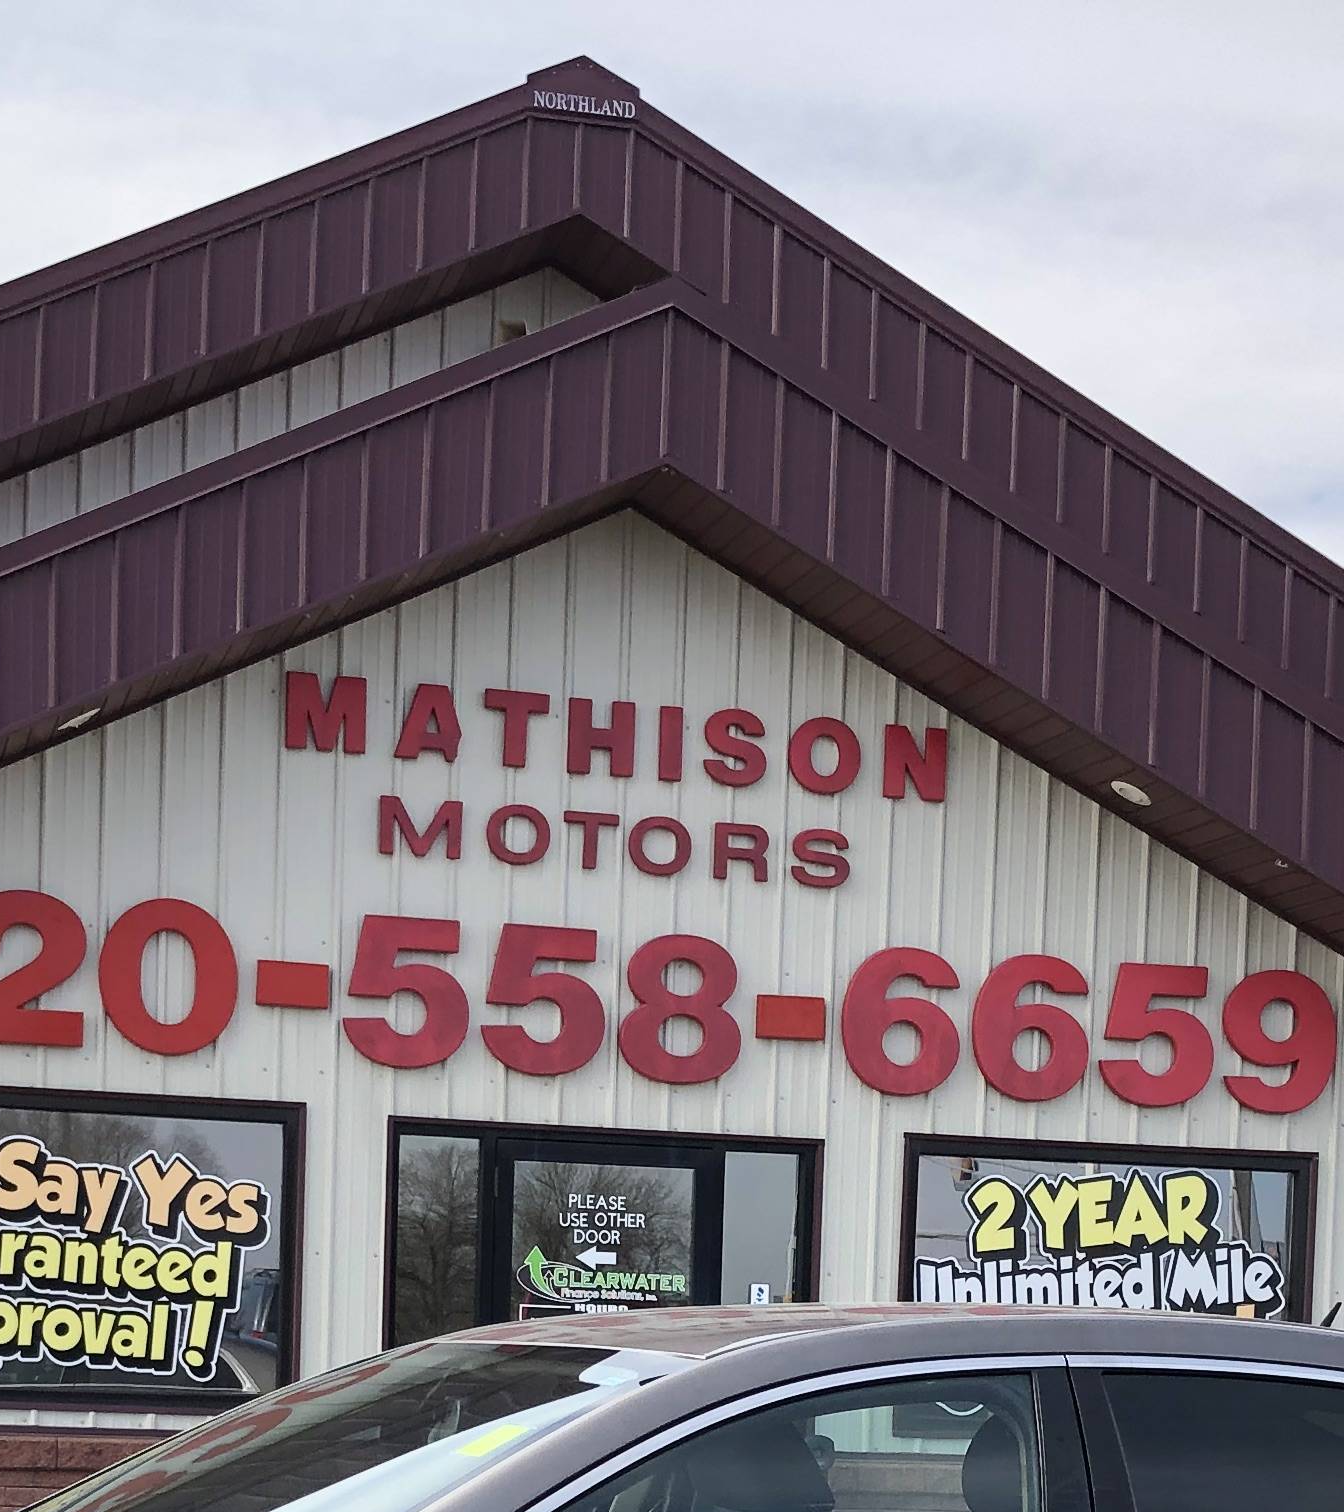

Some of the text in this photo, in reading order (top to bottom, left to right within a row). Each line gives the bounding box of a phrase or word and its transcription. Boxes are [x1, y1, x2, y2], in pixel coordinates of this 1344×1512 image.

[533, 90, 636, 119] NORTHLAND
[285, 670, 947, 802] MATHISON
[377, 795, 850, 888] MOTORS
[131, 1153, 261, 1236] Yes
[568, 1193, 627, 1211] PLEASE
[967, 1172, 1210, 1254] 2 YEAR
[559, 1212, 646, 1229] USE OTHER
[573, 1229, 622, 1245] DOOR
[553, 1267, 686, 1293] CLEARWATER
[915, 1246, 1278, 1310] Unlimited Mile
